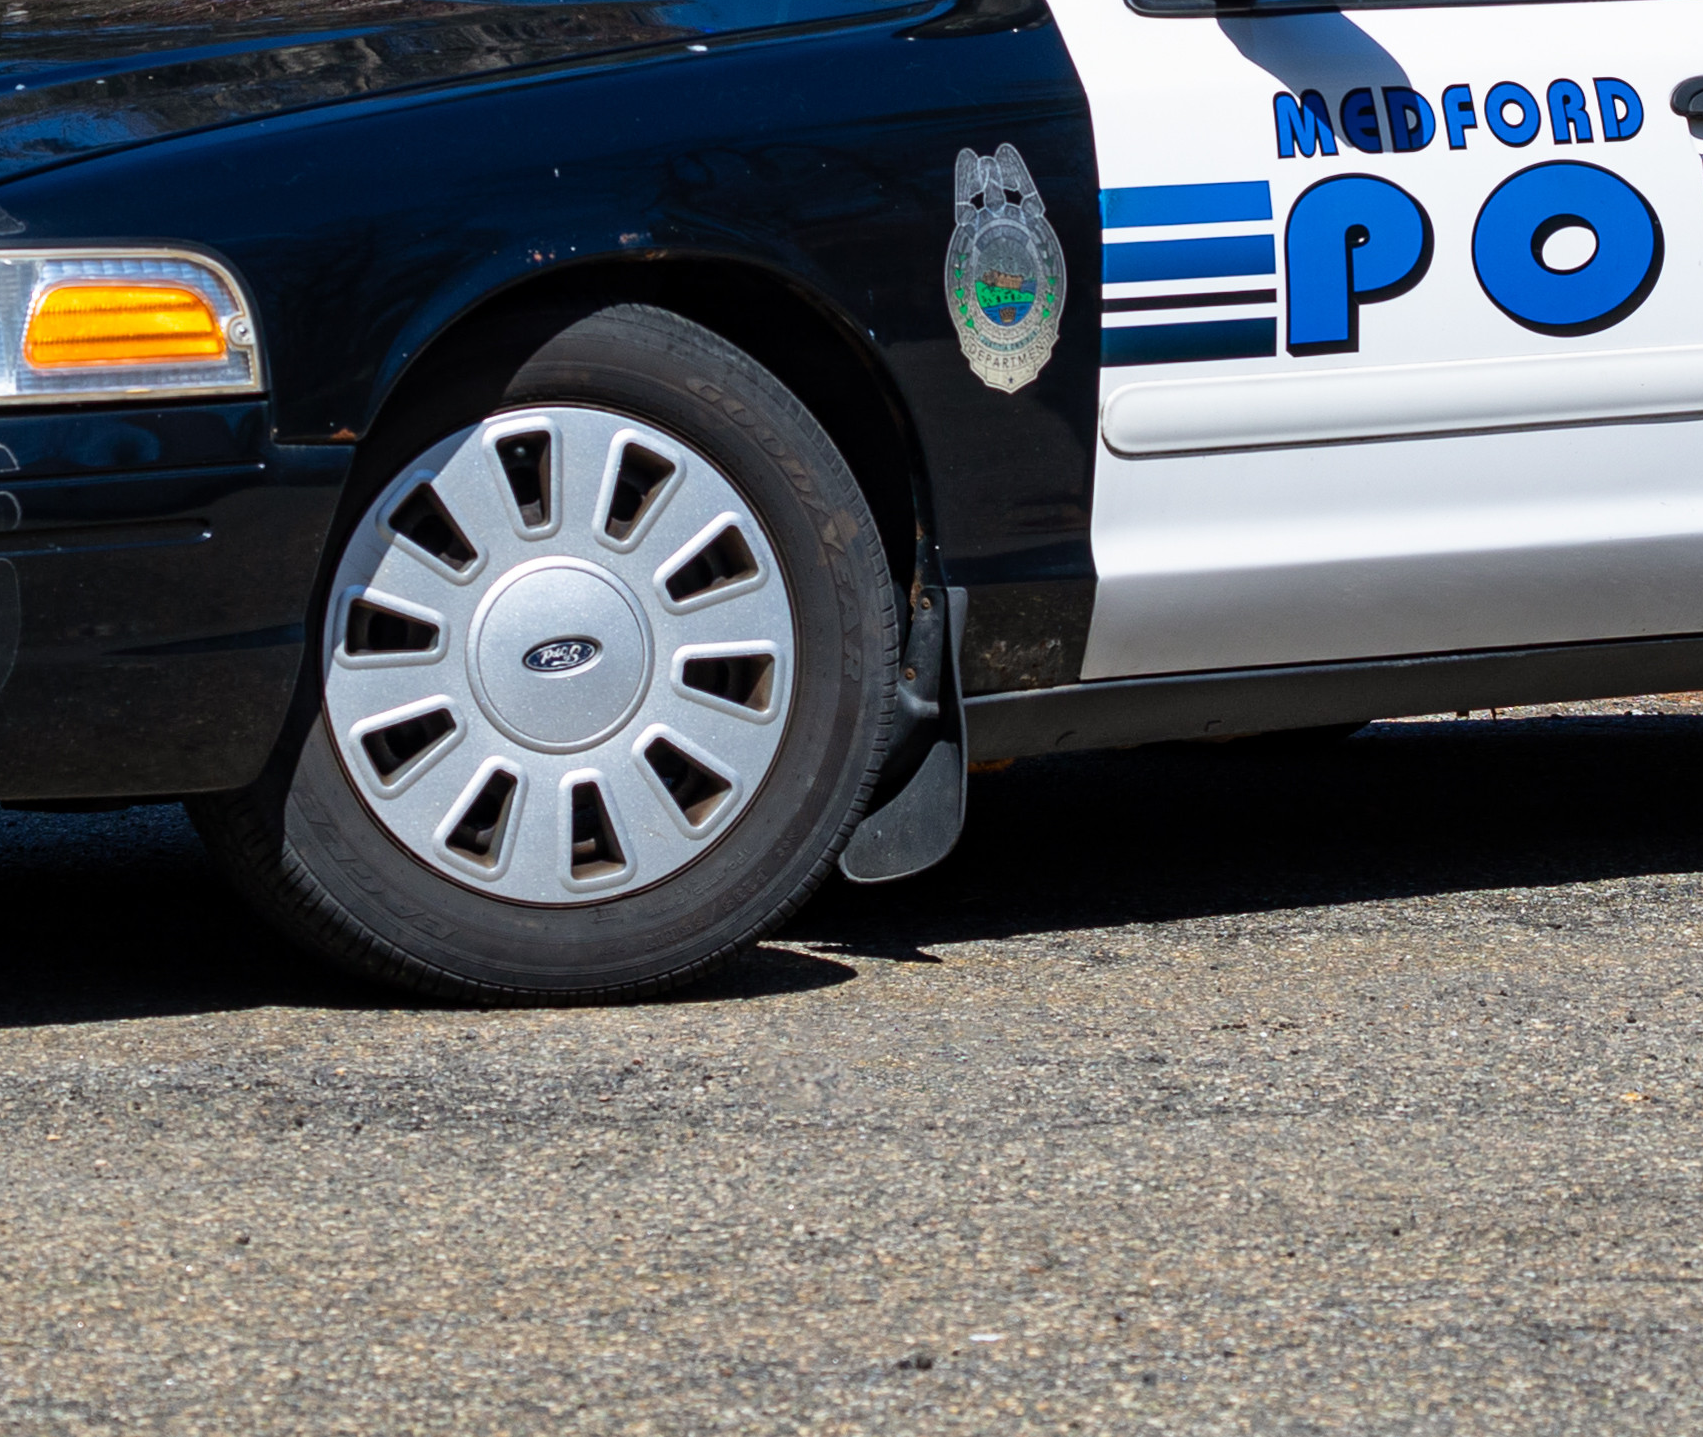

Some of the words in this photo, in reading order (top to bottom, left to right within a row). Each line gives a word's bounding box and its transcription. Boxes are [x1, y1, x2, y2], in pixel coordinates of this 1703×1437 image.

[1273, 77, 1644, 159] MEDFORD
[685, 376, 864, 684] GOODYEAR
[540, 644, 582, 666] Ford
